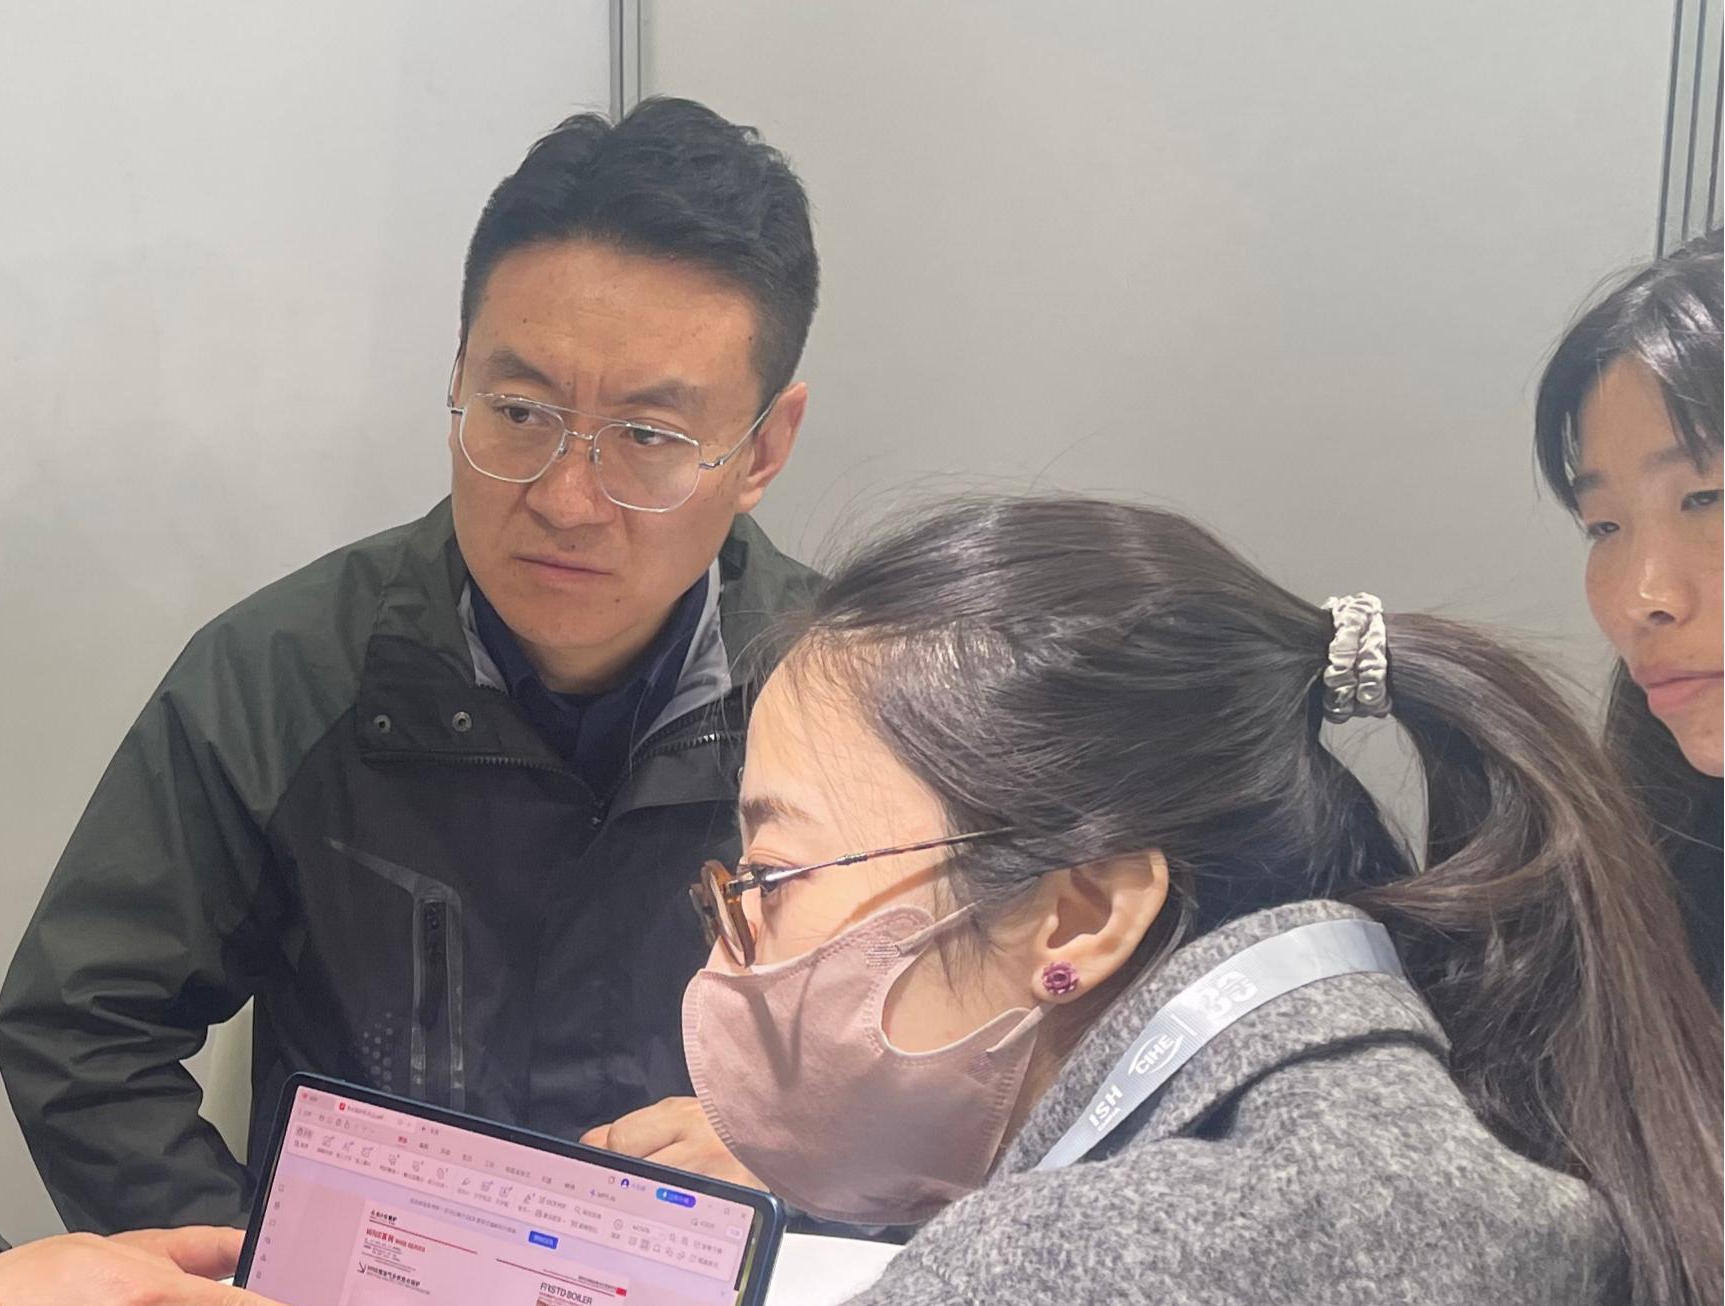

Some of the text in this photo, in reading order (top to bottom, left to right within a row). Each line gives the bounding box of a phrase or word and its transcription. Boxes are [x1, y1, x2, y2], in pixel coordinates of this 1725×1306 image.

[1089, 1085, 1123, 1127] ISH
[1135, 1035, 1175, 1074] CIHE
[566, 1289, 593, 1305] BOILER
